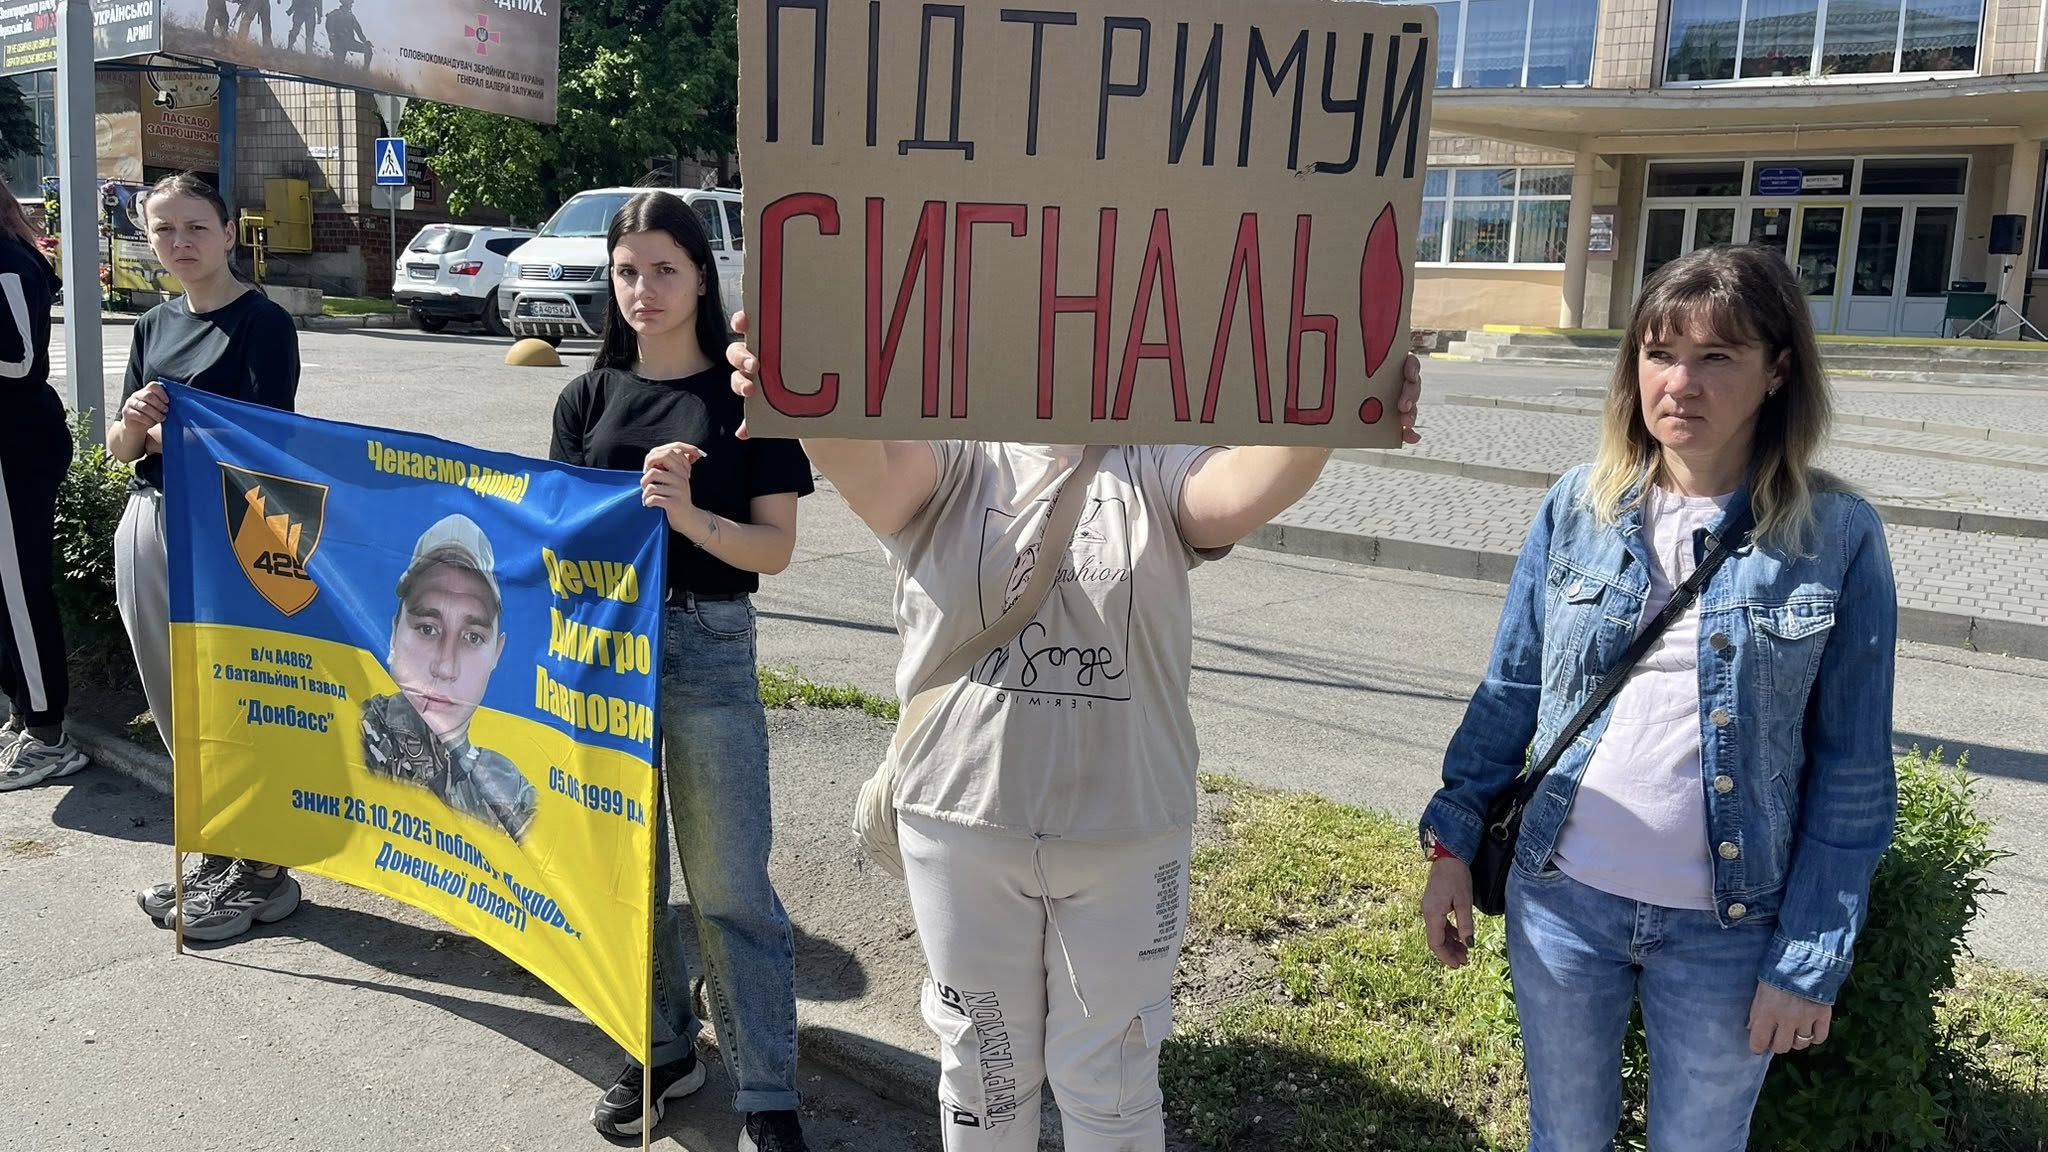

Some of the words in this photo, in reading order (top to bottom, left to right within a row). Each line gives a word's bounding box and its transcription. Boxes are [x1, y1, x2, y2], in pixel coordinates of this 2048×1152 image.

[93, 0, 153, 26] УКРАЇНСЬКОЇ
[126, 21, 153, 43] АРМІЇ
[399, 47, 473, 72] ГОЛОВНОКОМАНДУВАЧ
[473, 64, 506, 79] ЗБРОЙНИХ
[456, 74, 484, 88] ГЕНЕРАЛ
[485, 78, 511, 93] ВАЛЕРІЙ
[511, 84, 544, 99] ЗАЛУЖНИЙ
[765, 0, 1430, 179] ПІДТРИМУЙ
[162, 112, 211, 128] ЛАСКАВО
[759, 191, 1404, 426] СИГНАЛЬ!
[367, 440, 466, 487] Чекаємо
[467, 463, 530, 504] вдома!
[542, 547, 639, 603] Дечко
[1055, 554, 1129, 584] ashion
[250, 646, 273, 663] в/ч
[275, 648, 313, 670] А4862
[548, 606, 651, 675] Дмитро
[213, 663, 222, 679] 2
[225, 664, 299, 689] батальйон
[300, 675, 307, 690] 1
[308, 679, 347, 701] взвод
[549, 765, 623, 817] 05.06.1999
[292, 789, 340, 818] зник
[343, 795, 432, 847] 26.10.2025
[374, 840, 469, 897] Донецької
[467, 881, 527, 934] області
